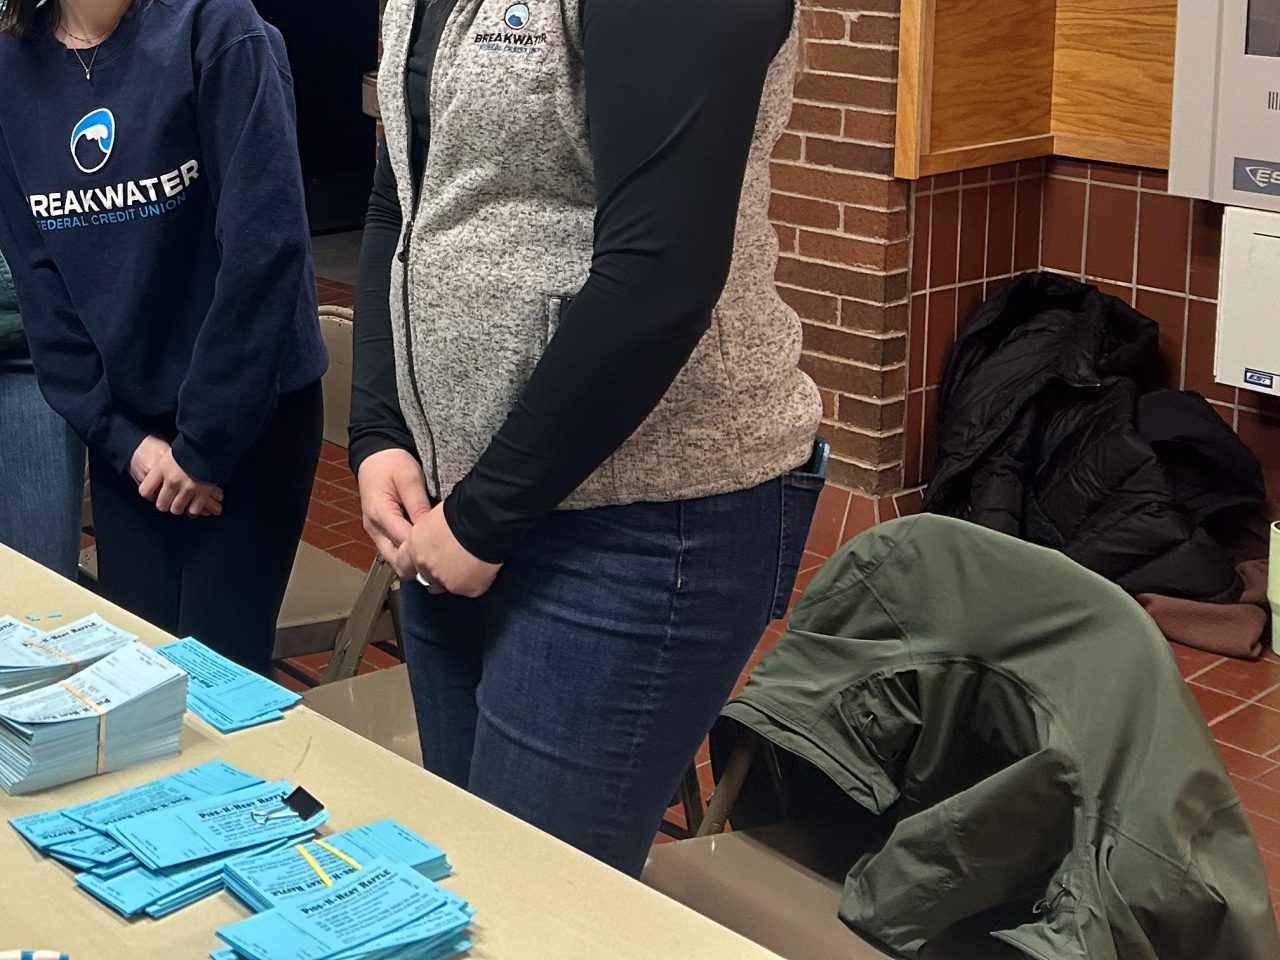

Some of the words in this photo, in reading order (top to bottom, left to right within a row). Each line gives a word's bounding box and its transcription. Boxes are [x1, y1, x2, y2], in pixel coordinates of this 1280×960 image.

[474, 32, 547, 46] BREAKWATER
[25, 159, 200, 218] REAKWATER
[92, 207, 136, 226] CREDIT
[140, 192, 186, 218] UNION
